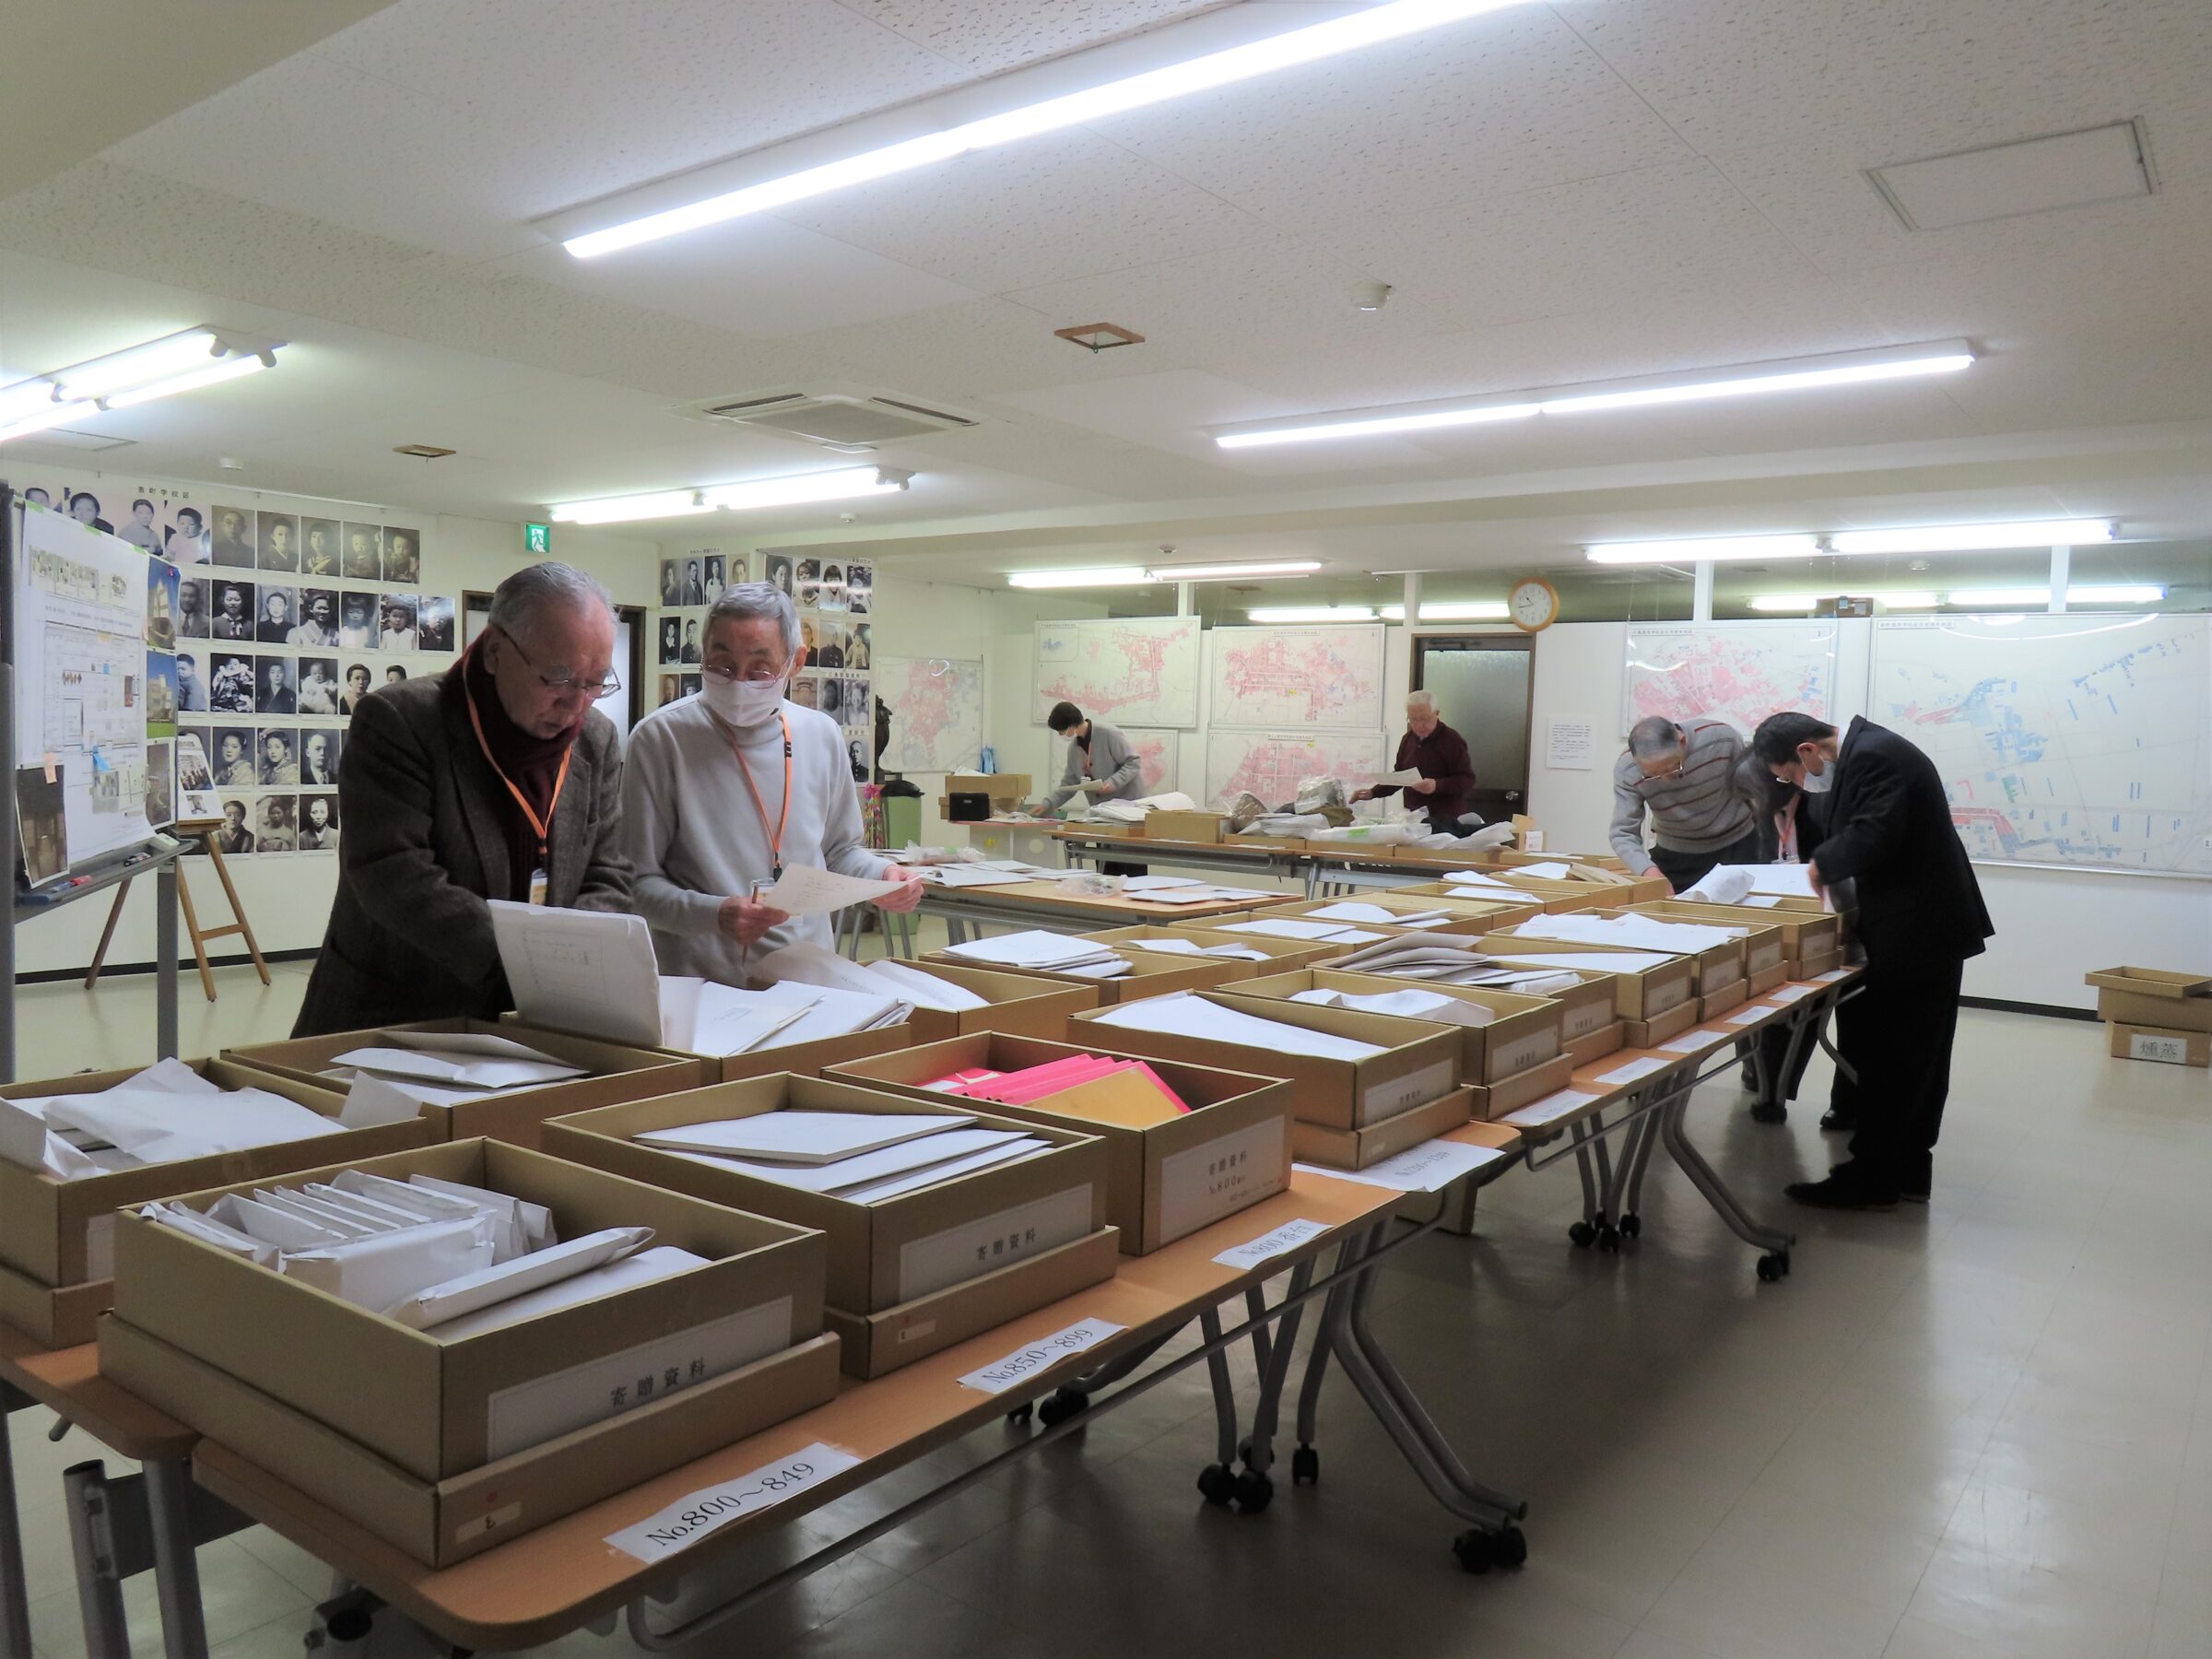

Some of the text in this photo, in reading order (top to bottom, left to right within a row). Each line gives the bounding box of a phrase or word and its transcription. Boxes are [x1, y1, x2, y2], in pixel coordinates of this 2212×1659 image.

[977, 1227, 1037, 1262] 寄贈資料
[609, 1356, 708, 1408] 寄贈資料
[645, 1462, 816, 1547] No.800～849
